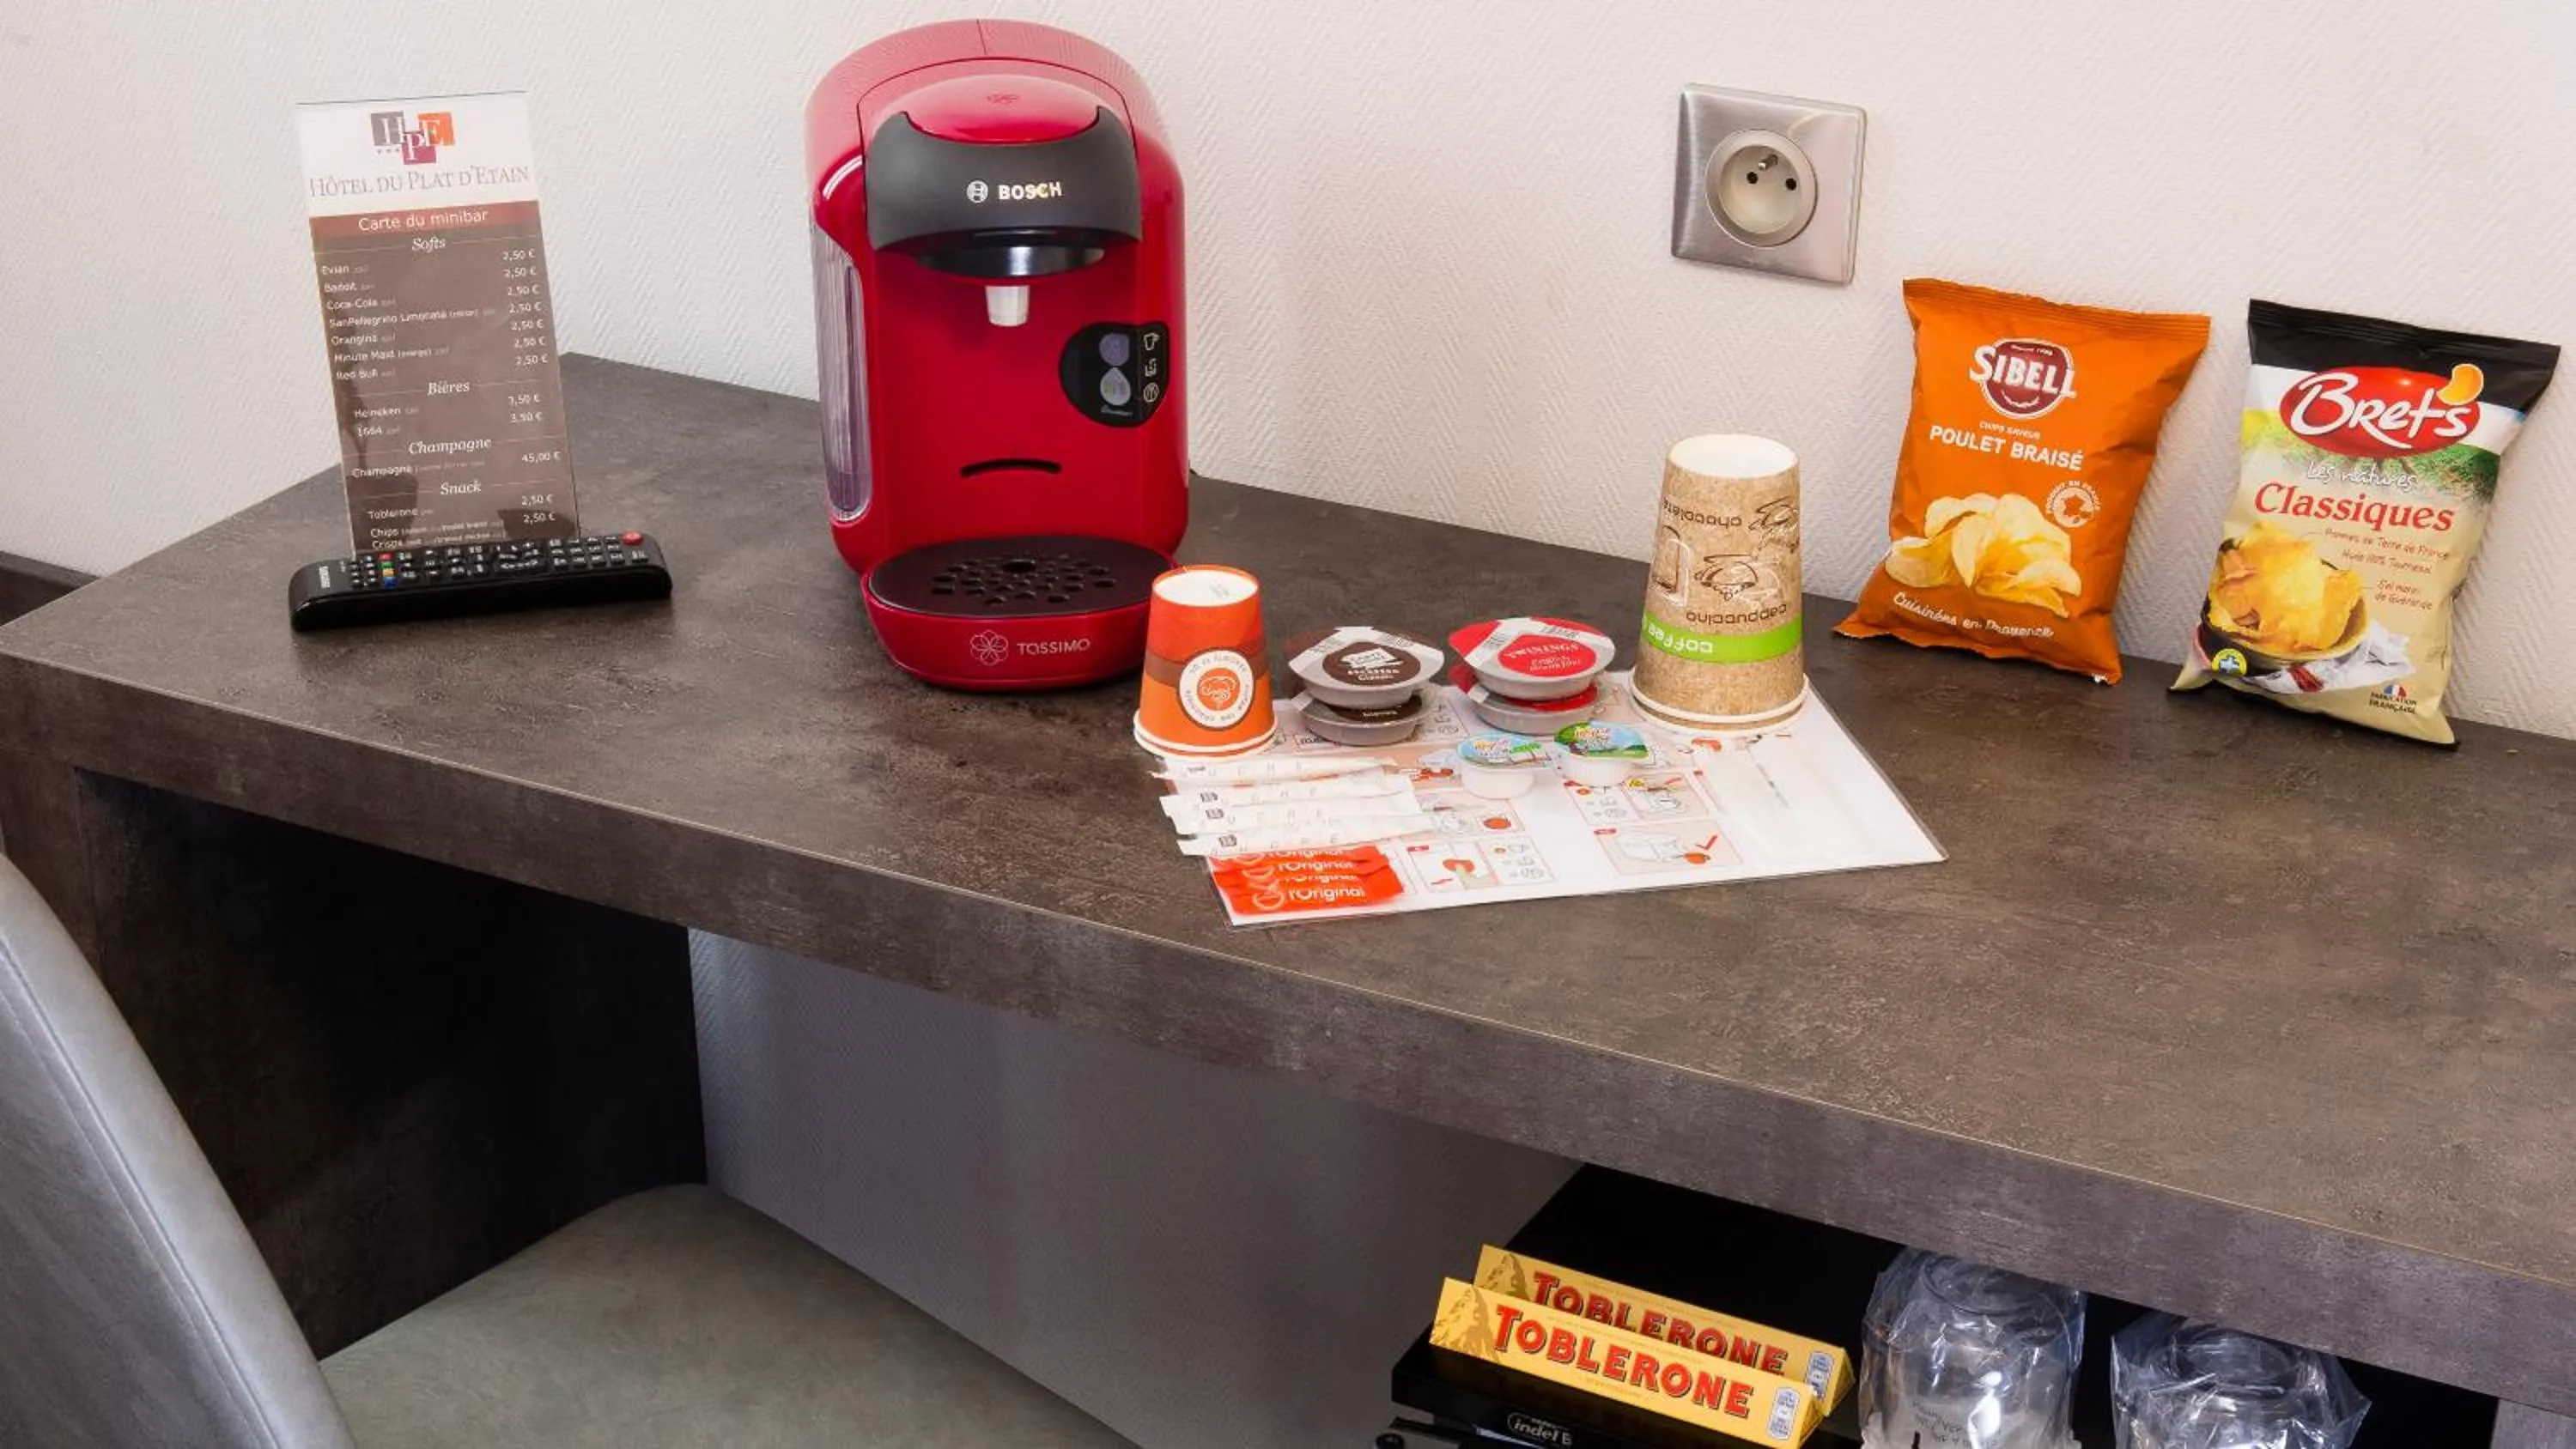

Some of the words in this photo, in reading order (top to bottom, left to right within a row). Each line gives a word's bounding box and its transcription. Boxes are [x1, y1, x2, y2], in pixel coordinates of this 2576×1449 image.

[310, 174, 374, 197] HÔTEL
[377, 177, 404, 194] DU
[407, 170, 459, 191] PLAT
[999, 181, 1062, 200] BOSCH
[358, 216, 400, 232] Carte
[406, 214, 425, 227] du
[430, 209, 489, 225] minibar
[411, 235, 446, 252] Softs
[322, 265, 349, 275] Evian
[326, 298, 378, 310] Coca-Cola
[331, 335, 377, 347] Orangina
[1969, 345, 2076, 398] SIBELL
[428, 380, 471, 396] Bières
[355, 407, 401, 419] Heineken
[2290, 372, 2471, 449] Brets
[408, 438, 492, 455] Champagne
[1929, 425, 2006, 454] POULET
[2009, 440, 2084, 471] BRAISÉ
[352, 465, 412, 478] Champagne
[2307, 460, 2336, 484] Les
[440, 479, 482, 495] Snack
[2255, 482, 2456, 532] Classiques
[370, 527, 399, 539] Chips
[1686, 603, 1787, 626] cappuccino
[1893, 591, 1957, 626] Cuisinées
[1985, 619, 2055, 639] Provence
[1507, 642, 1581, 659] TWININGS
[1648, 626, 1714, 654] coffee
[1533, 1270, 1789, 1377] TOBLERONE
[1494, 1304, 1754, 1419] TOBLERONE
[1514, 1417, 1559, 1442] indel
